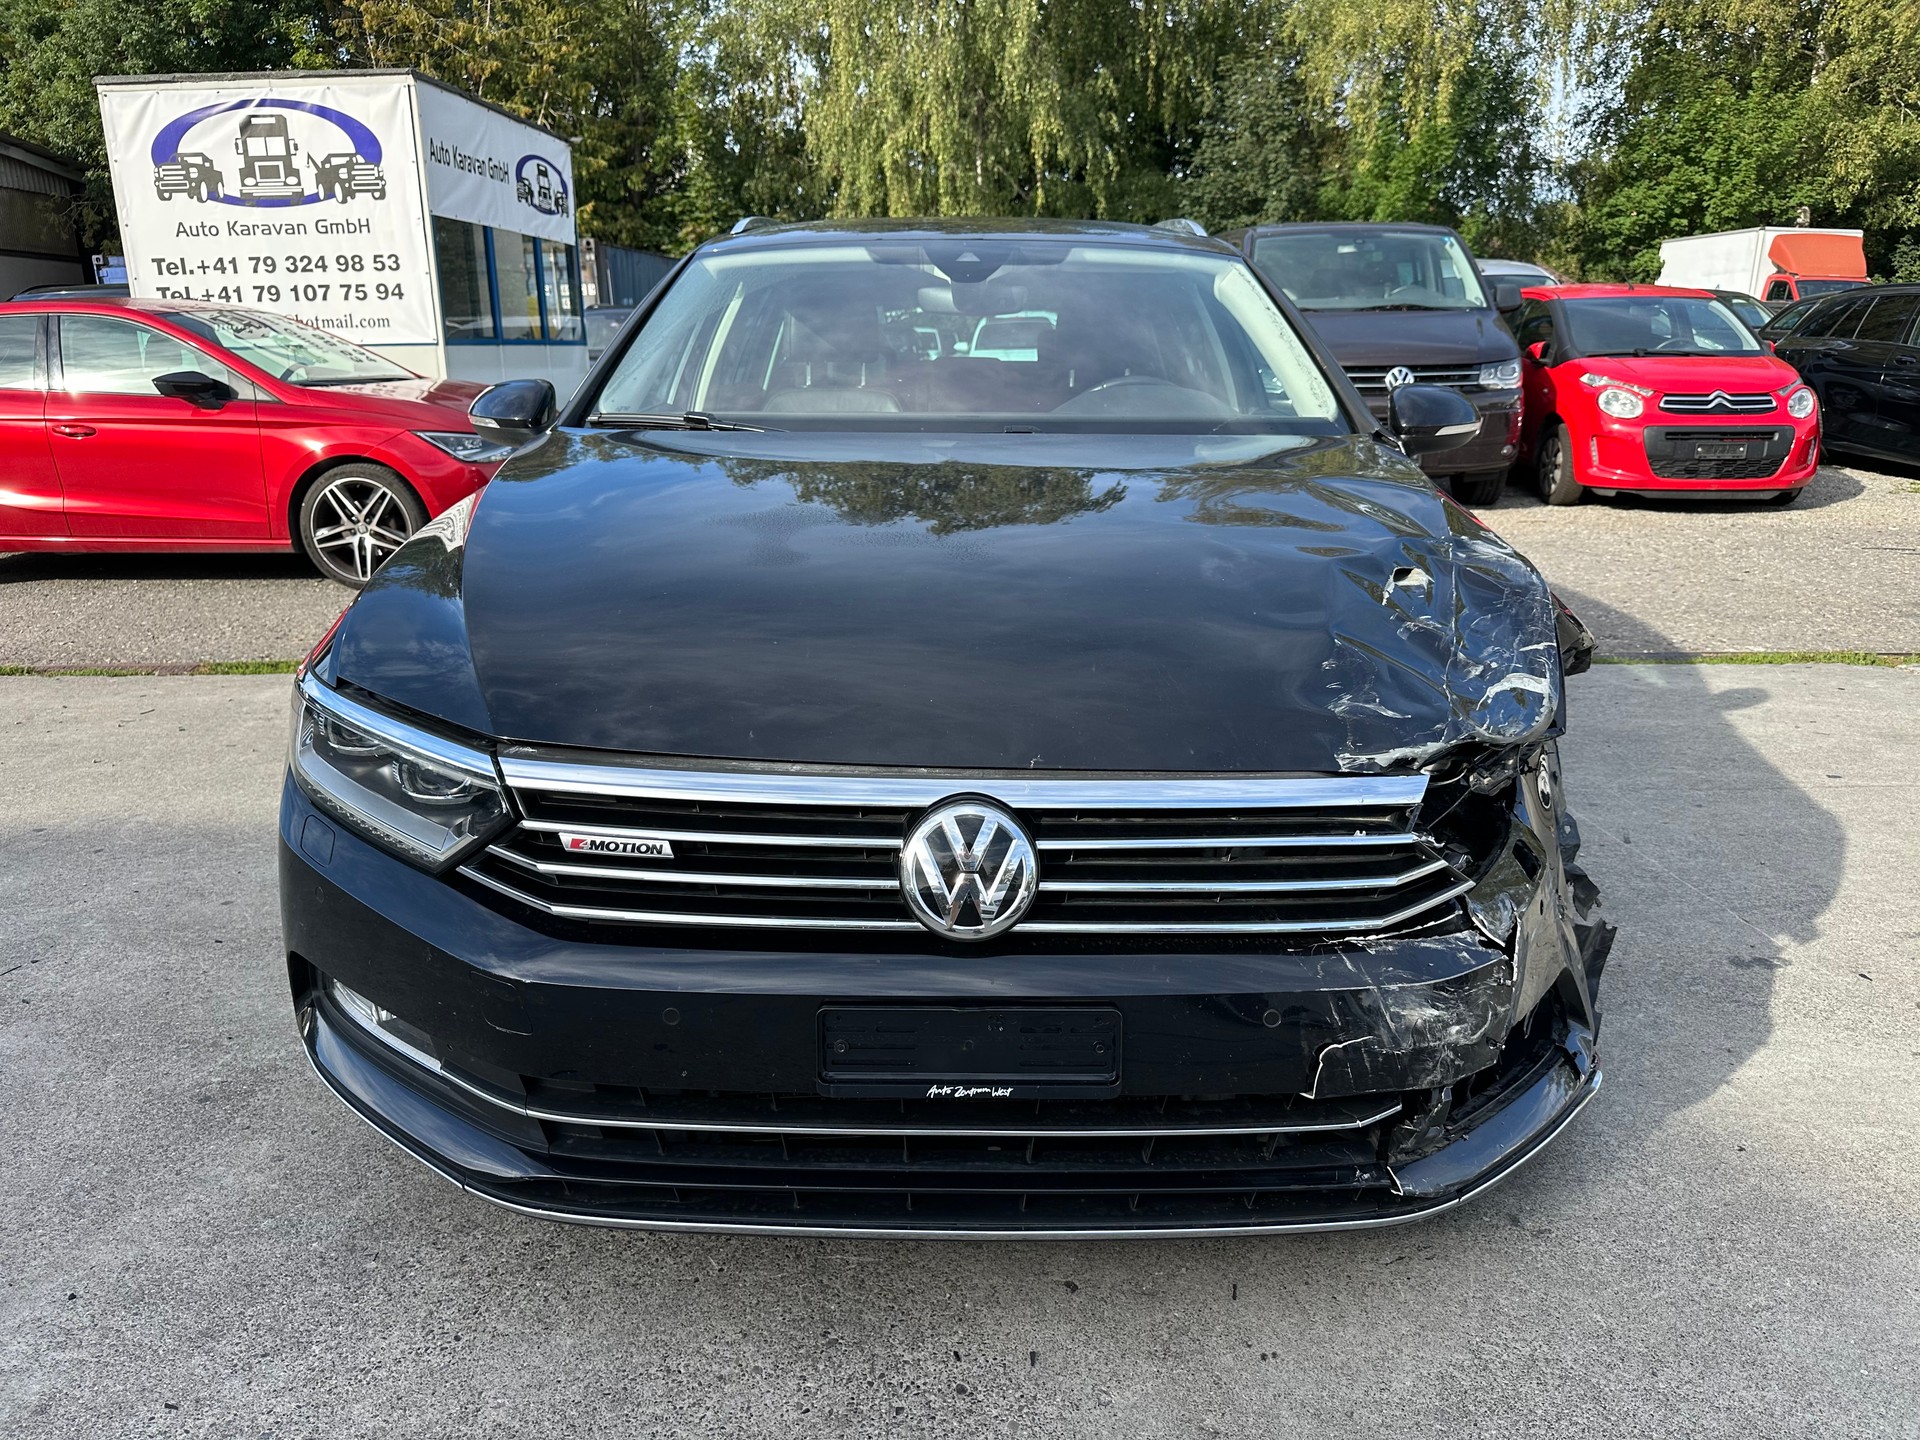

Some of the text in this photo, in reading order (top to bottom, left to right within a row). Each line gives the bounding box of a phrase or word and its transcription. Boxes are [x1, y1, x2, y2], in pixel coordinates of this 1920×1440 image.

[429, 137, 510, 184] Auto Karavan GmbH
[175, 218, 371, 238] Auto Karavan GmbH
[151, 253, 401, 276] Tel.+41 79 324 98 53
[252, 284, 281, 303] 79
[289, 284, 331, 302] 107
[339, 283, 368, 302] 75
[375, 282, 405, 301] 94
[570, 837, 664, 856] 4MOTION
[903, 803, 1038, 938] VW
[926, 1084, 954, 1099] Auto
[991, 1086, 1014, 1097] West
